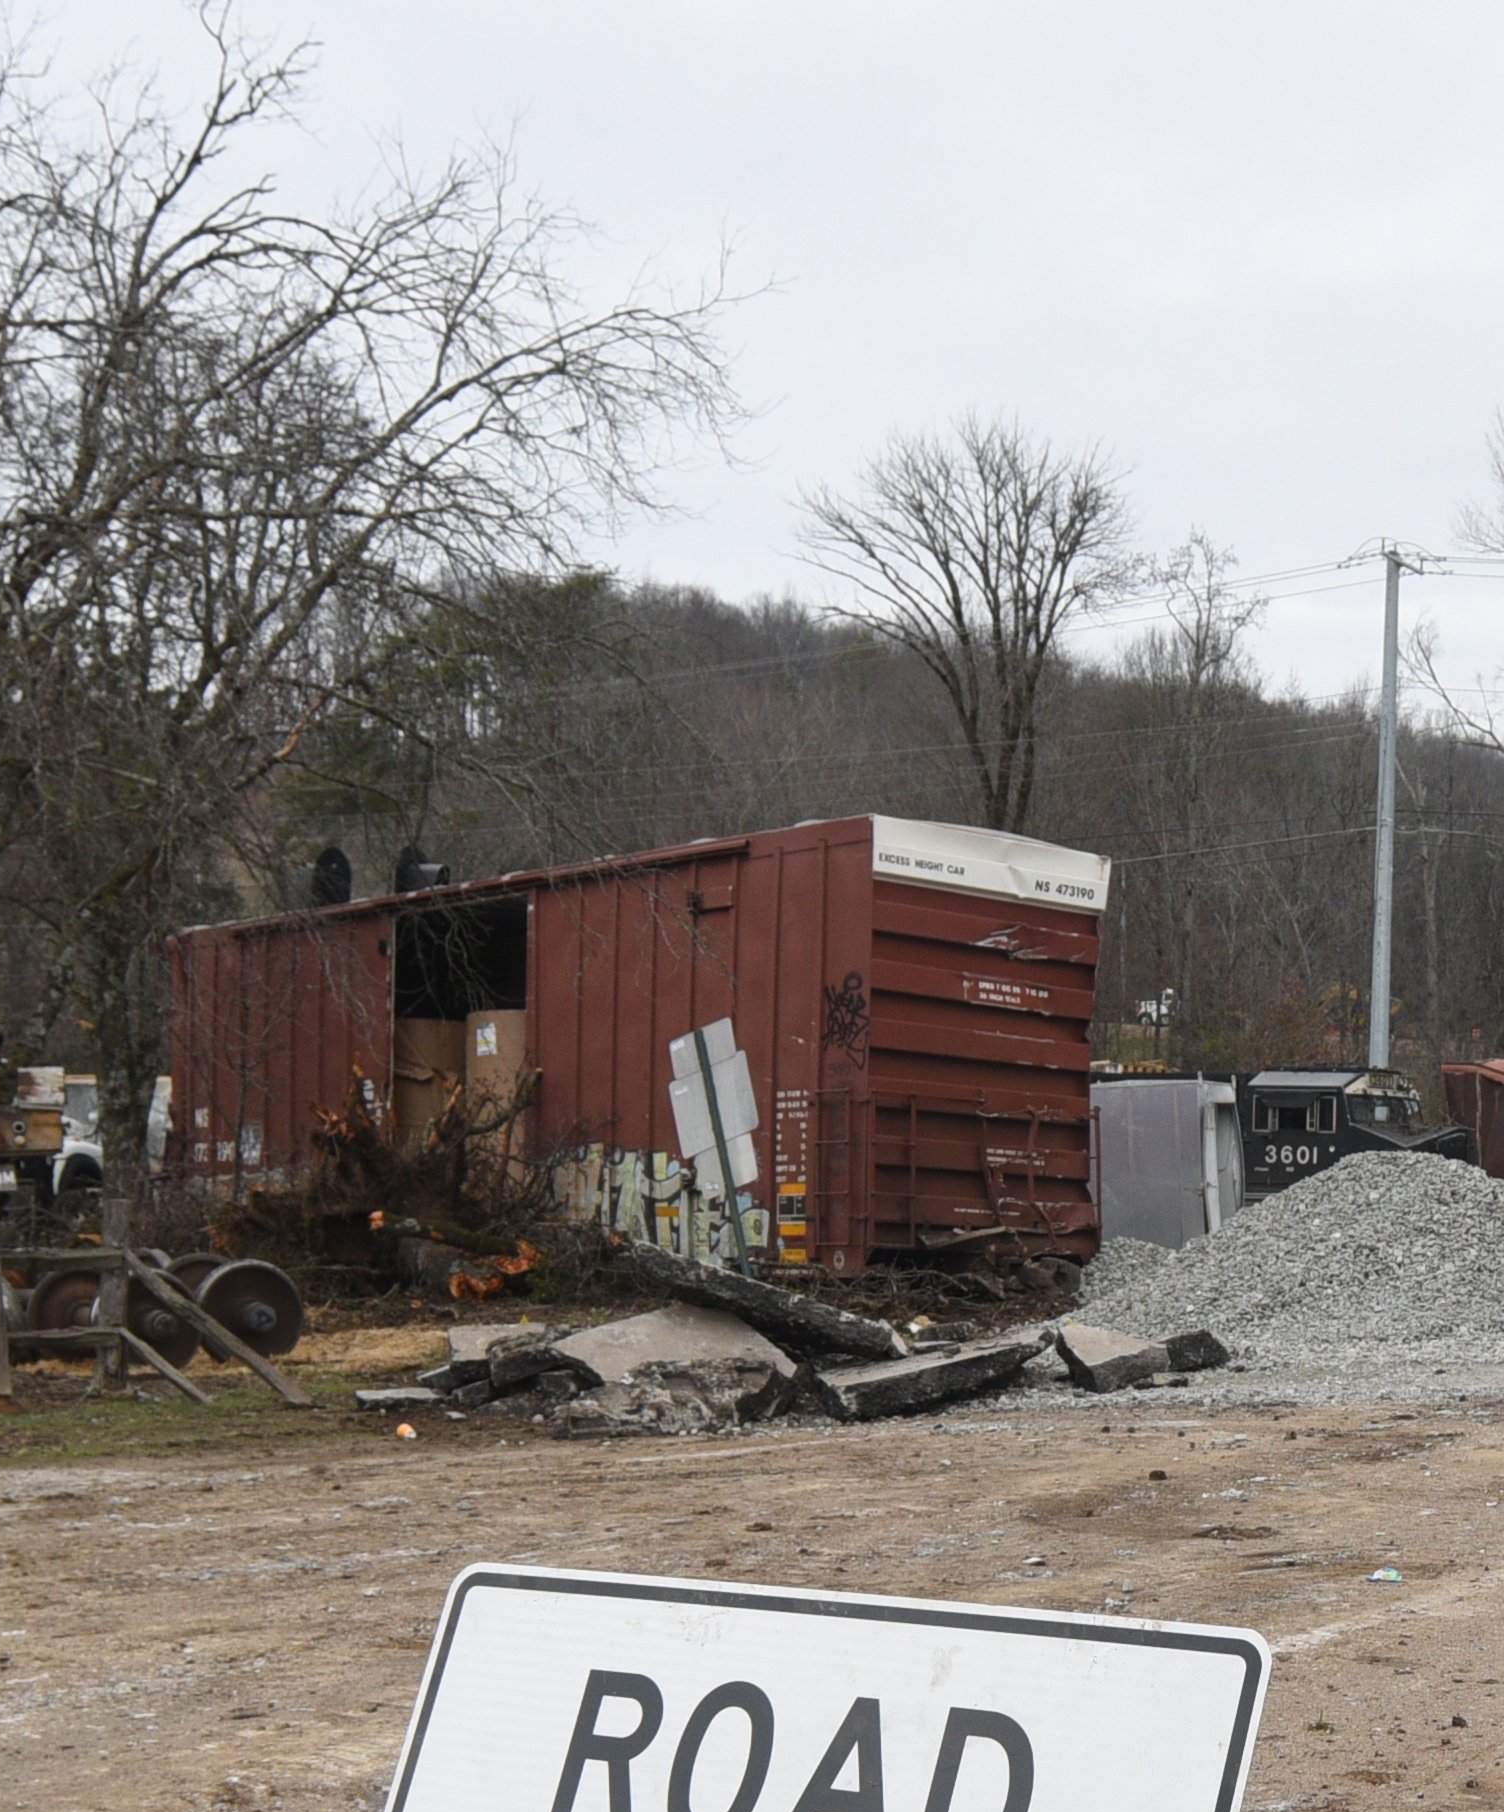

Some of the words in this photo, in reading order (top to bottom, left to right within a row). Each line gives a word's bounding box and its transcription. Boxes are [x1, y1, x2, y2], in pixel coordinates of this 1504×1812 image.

[878, 852, 911, 867] EXCESS
[914, 859, 944, 873] HEIGHT
[947, 864, 966, 876] CAR
[1034, 879, 1051, 893] NS
[1055, 883, 1095, 900] 473190
[1264, 1144, 1318, 1165] 3601
